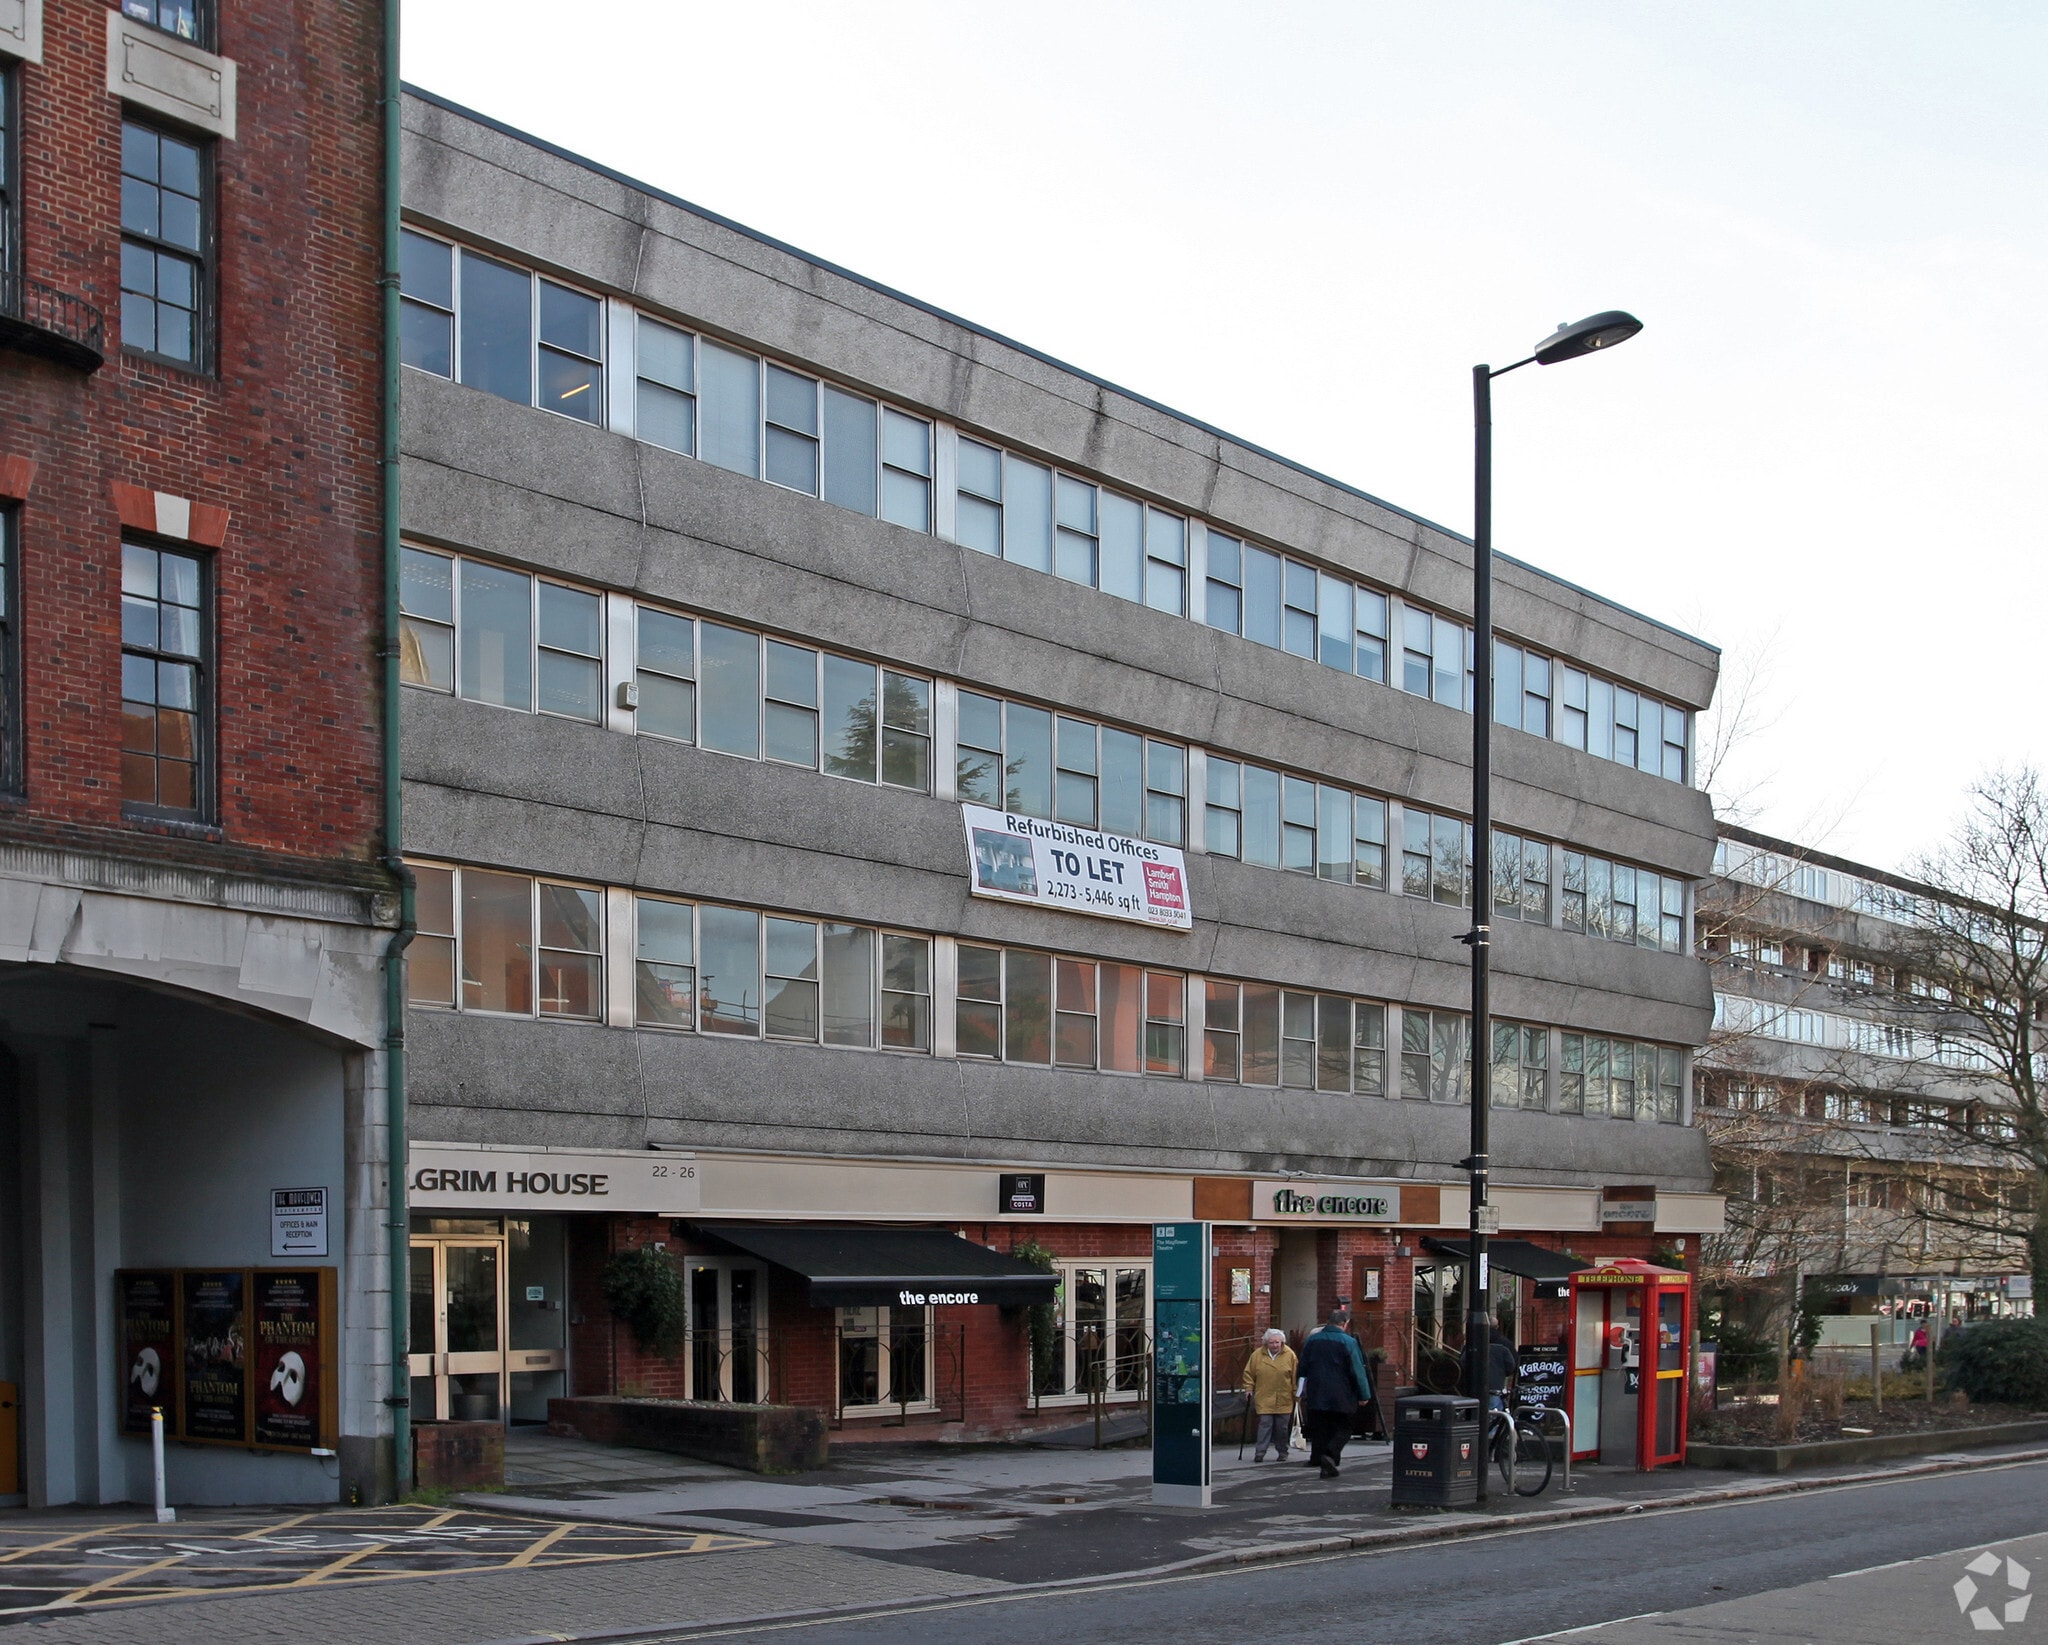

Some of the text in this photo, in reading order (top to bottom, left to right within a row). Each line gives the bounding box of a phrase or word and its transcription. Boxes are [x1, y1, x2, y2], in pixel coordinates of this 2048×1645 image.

[1006, 815, 1159, 861] Refurbished Offices
[1051, 849, 1125, 884] TO LET
[1146, 867, 1176, 881] Lambert
[1148, 878, 1169, 890] Smith
[1047, 880, 1077, 899] 2,273
[1085, 887, 1114, 906] 5,446
[1118, 896, 1130, 912] sq
[1132, 895, 1141, 911] ft
[1149, 888, 1182, 903] Hampton
[652, 1165, 668, 1178] 22
[679, 1166, 695, 1178] 26
[409, 1168, 609, 1195] GRIM HOUSE
[1273, 1188, 1389, 1216] the encore
[280, 1220, 300, 1228] OFFICES
[305, 1220, 318, 1228] MAIN
[285, 1230, 313, 1238] RECEPTION
[1583, 1275, 1641, 1283] TELEPHONE
[899, 1290, 979, 1305] the encore
[1557, 1286, 1570, 1298] the
[260, 1321, 315, 1336] PHANTOM
[190, 1380, 238, 1396] PHANTOM
[1519, 1385, 1563, 1394] URSDAY
[1405, 1469, 1433, 1477] LITTER
[84, 1525, 533, 1560] CLEAR
